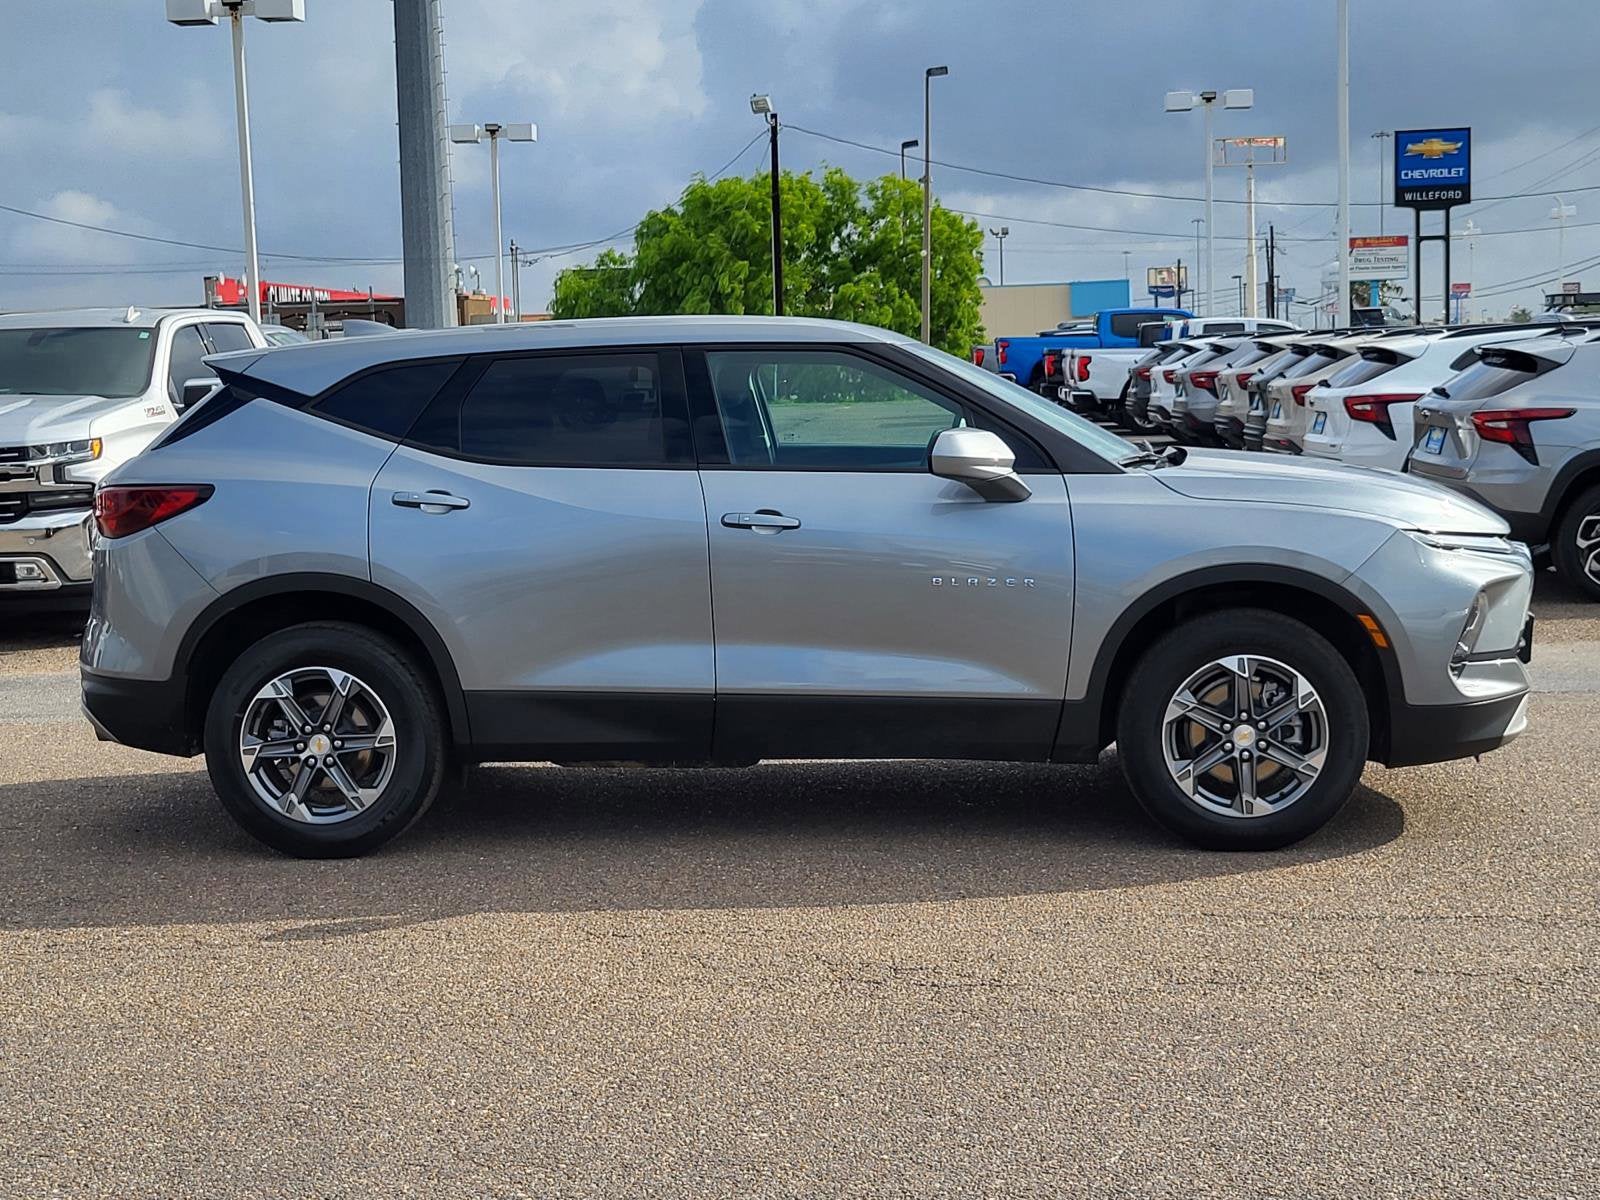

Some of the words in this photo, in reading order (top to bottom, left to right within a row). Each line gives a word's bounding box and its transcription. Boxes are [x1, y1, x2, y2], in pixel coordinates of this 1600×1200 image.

[1401, 167, 1465, 180] CHEVROLET
[1404, 190, 1463, 201] WILLEFORD
[1373, 255, 1399, 263] TESTING
[269, 285, 300, 303] CLIMATE
[931, 577, 1035, 588] BLAZER
